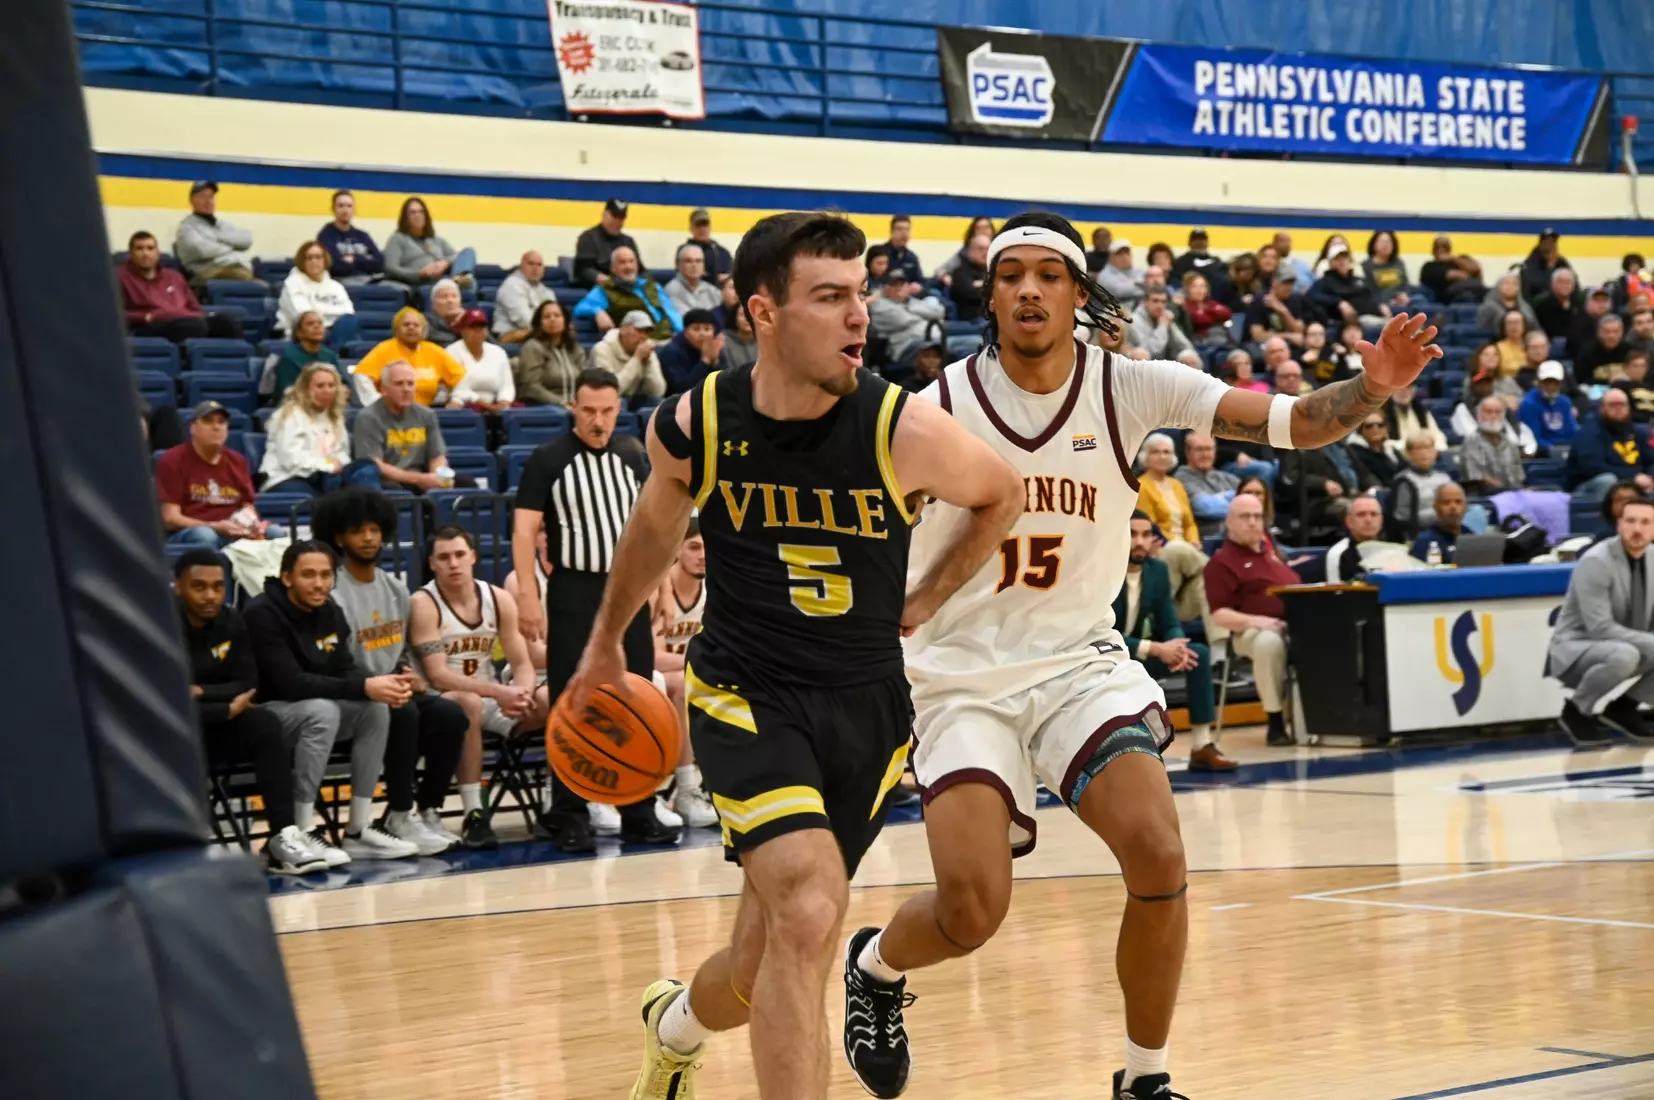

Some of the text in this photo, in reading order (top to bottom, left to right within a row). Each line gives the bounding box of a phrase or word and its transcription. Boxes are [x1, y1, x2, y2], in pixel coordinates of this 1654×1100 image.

[973, 72, 1047, 104] PSAC
[1194, 60, 1526, 114] PENNSYLVANIA STATE
[1192, 99, 1526, 151] ATHLETIC CONFERENCE
[1072, 437, 1097, 448] PSAC
[718, 479, 888, 540] VILLE
[777, 543, 854, 617] 5
[995, 534, 1065, 596] 15
